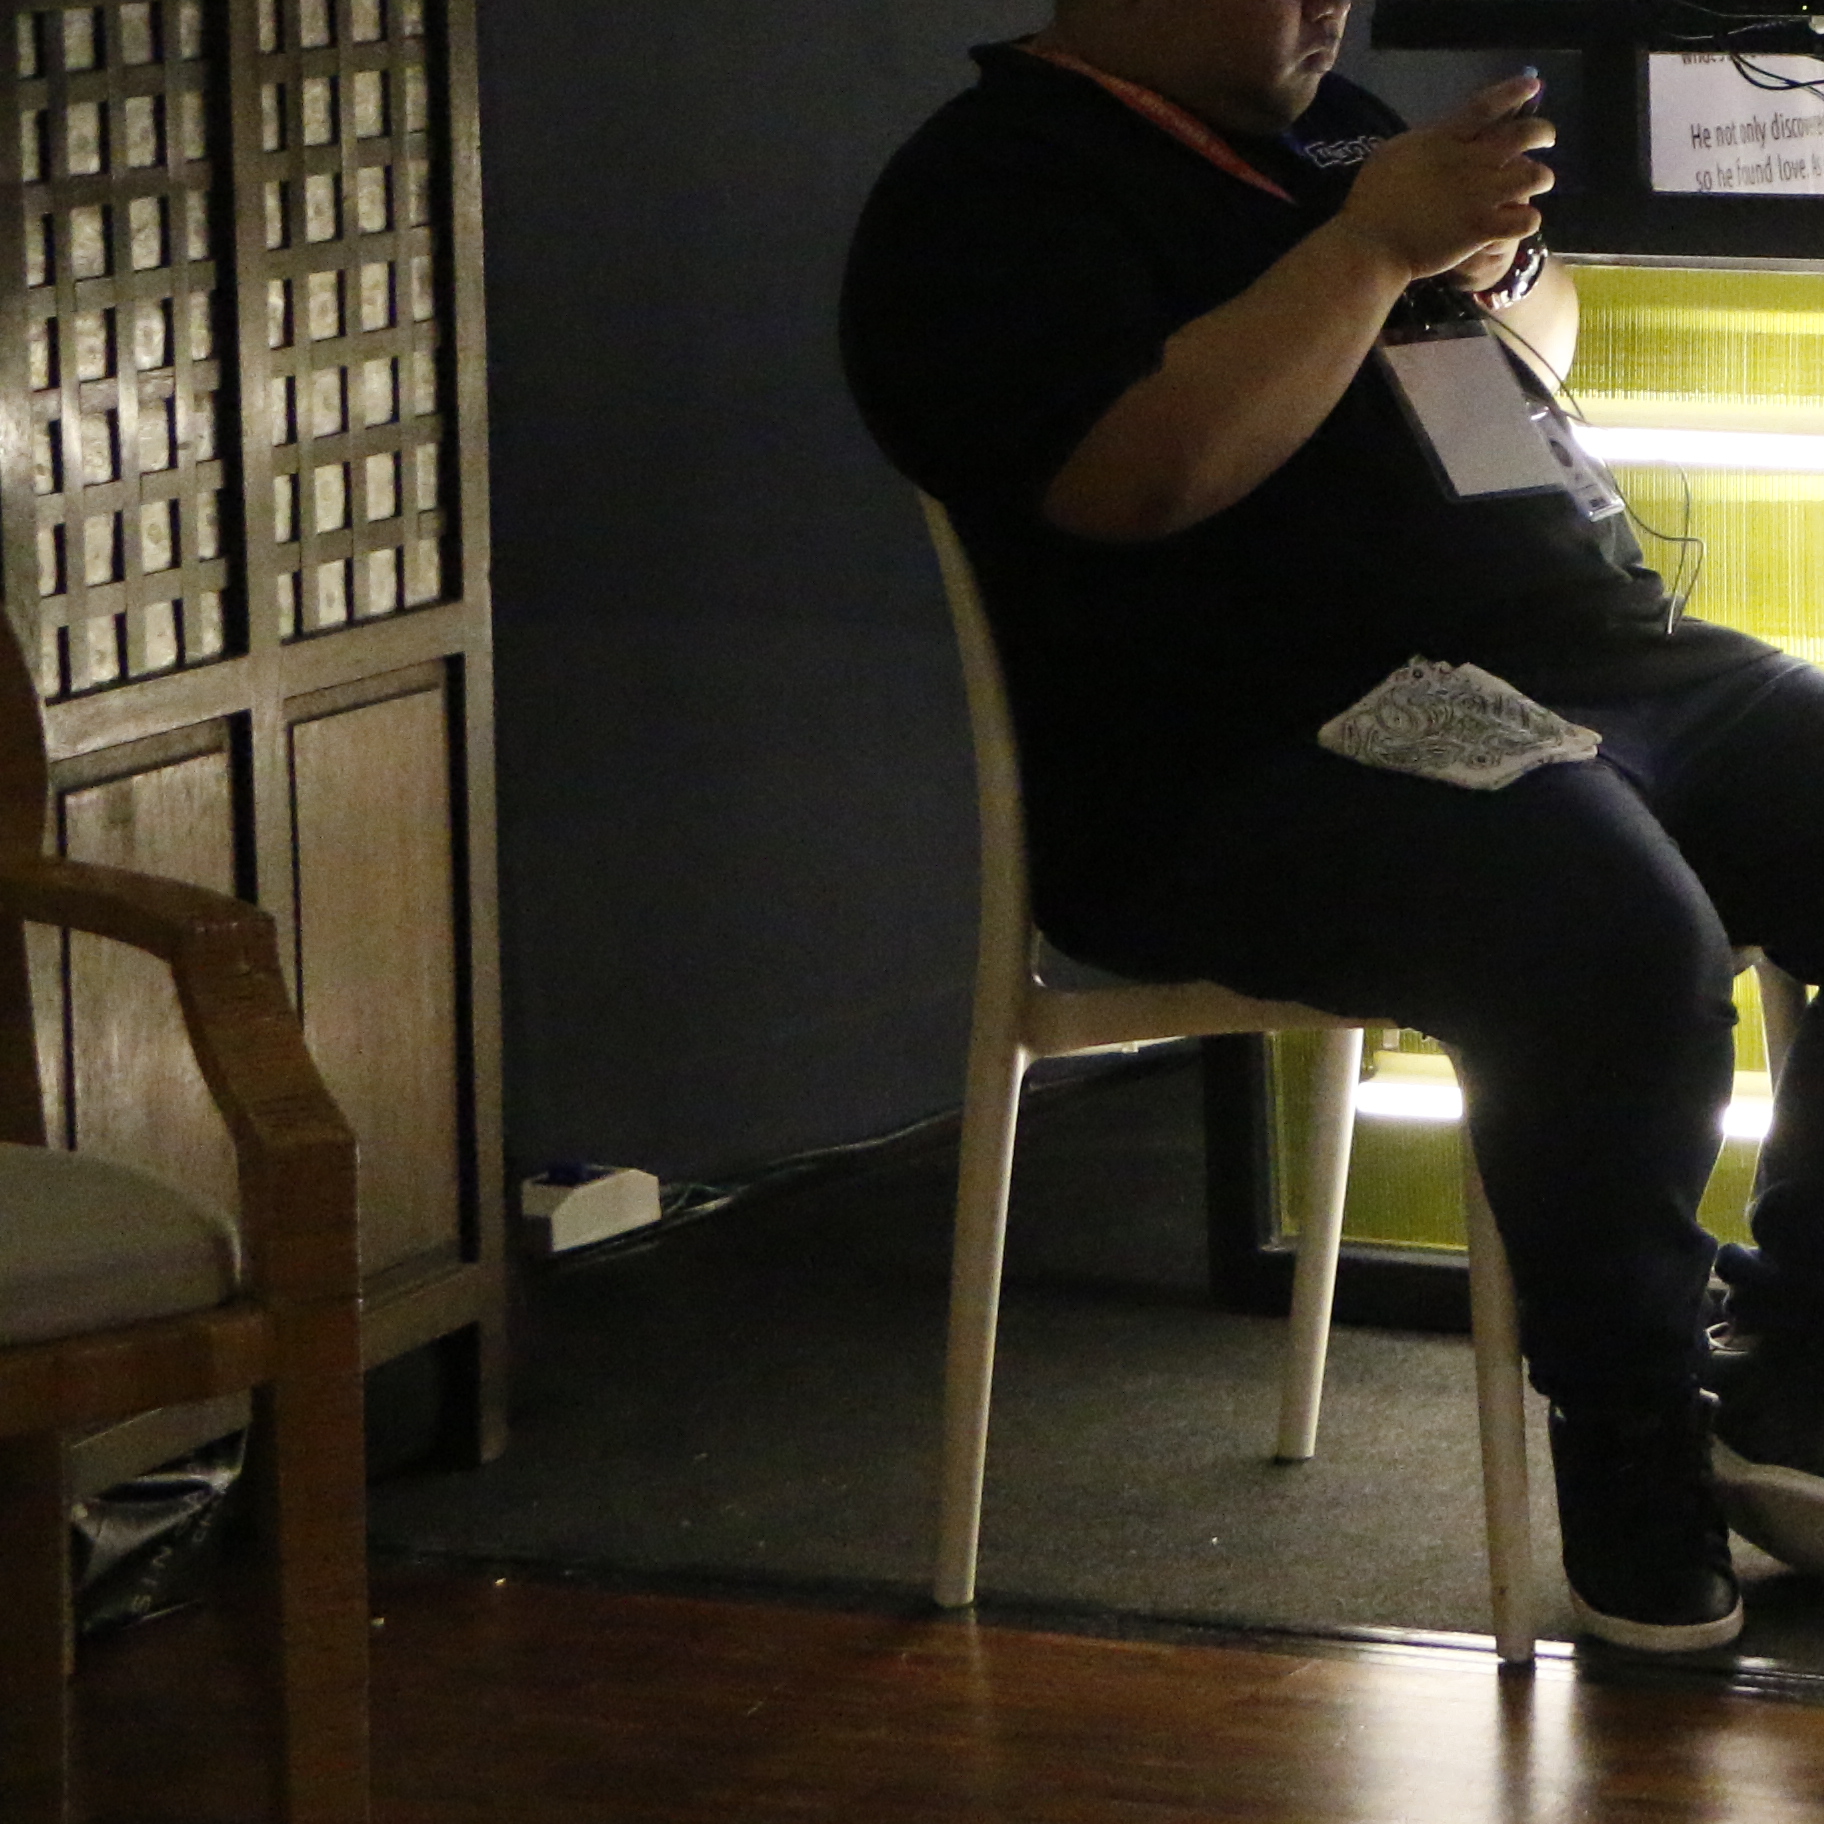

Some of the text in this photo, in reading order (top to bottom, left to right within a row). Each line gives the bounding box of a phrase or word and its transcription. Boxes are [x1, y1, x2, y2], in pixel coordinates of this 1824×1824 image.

[1690, 123, 1712, 150] He
[1716, 120, 1738, 147] not
[1740, 114, 1766, 150] only
[1695, 169, 1712, 190] so
[1716, 161, 1734, 188] he
